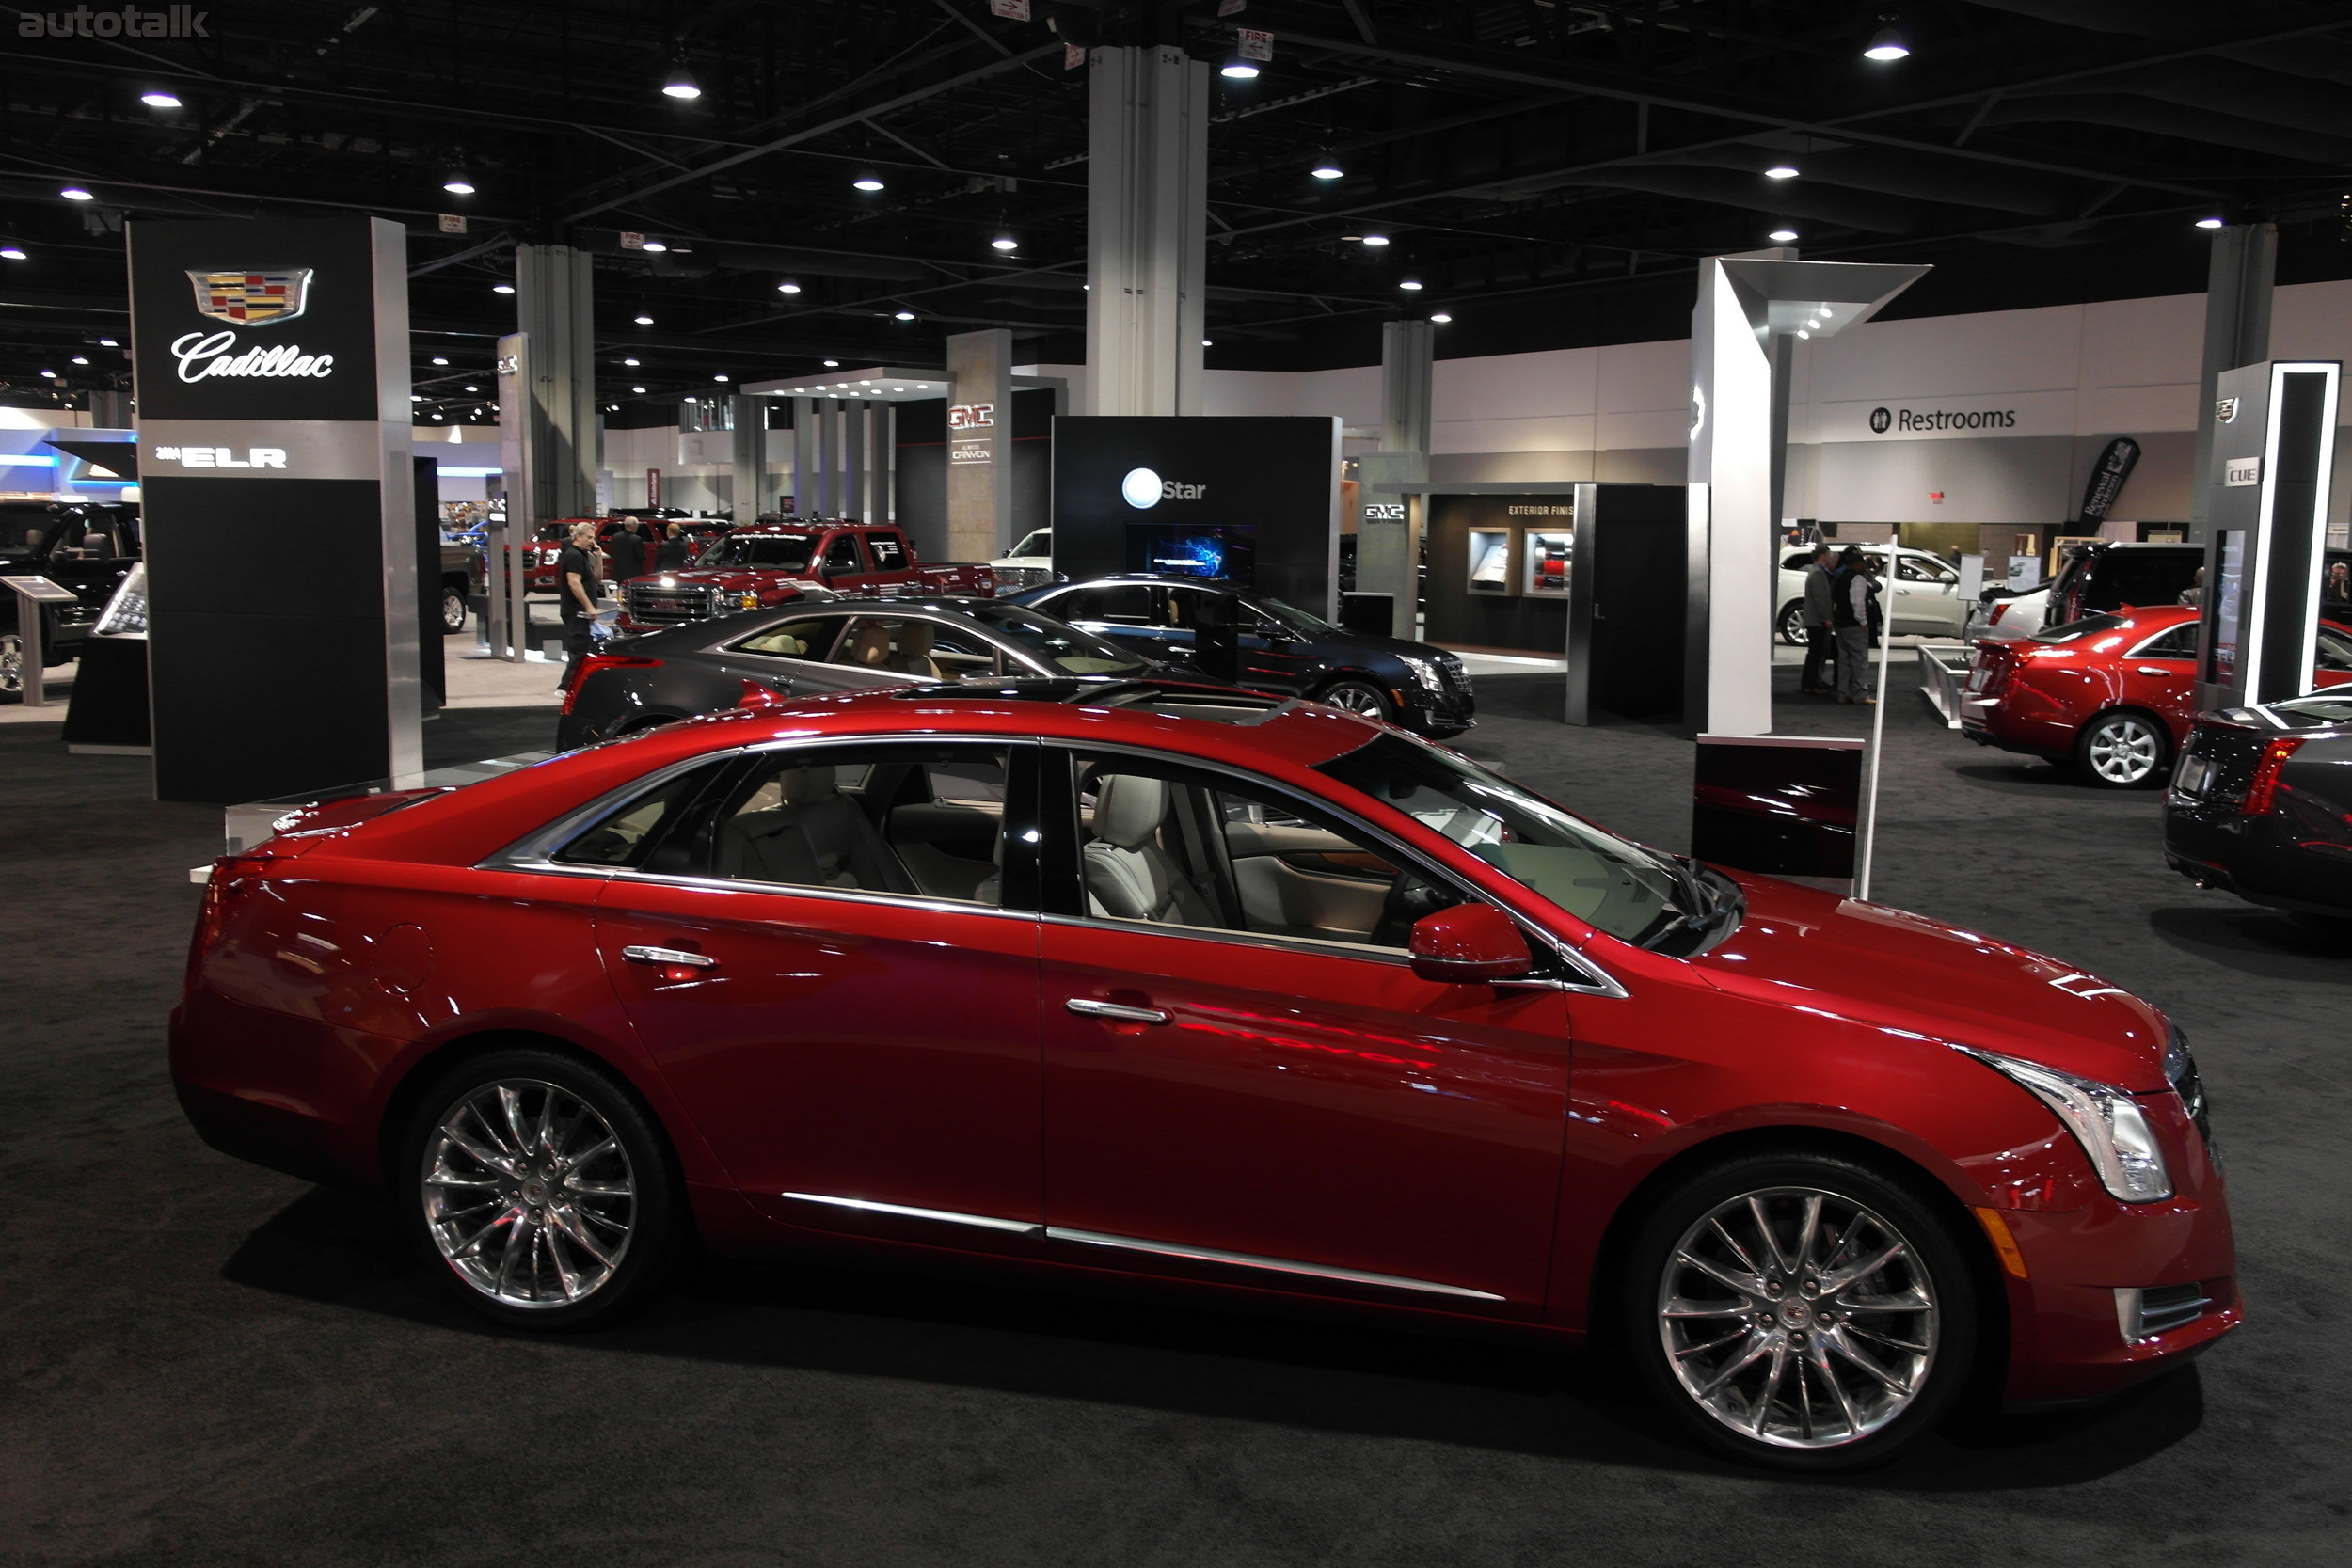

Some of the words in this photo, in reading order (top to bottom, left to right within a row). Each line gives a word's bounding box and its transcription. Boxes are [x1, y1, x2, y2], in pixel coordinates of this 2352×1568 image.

[1245, 30, 1267, 43] FIRE
[170, 330, 334, 383] Cadillac
[948, 404, 994, 429] GMC
[1899, 408, 2016, 432] Restrooms
[181, 447, 287, 468] ELR
[952, 450, 991, 459] CANYON
[2230, 468, 2256, 483] CUE
[2084, 471, 2111, 515] Renewal
[1365, 504, 1405, 520] GMC
[1508, 505, 1549, 515] EXTERIOR
